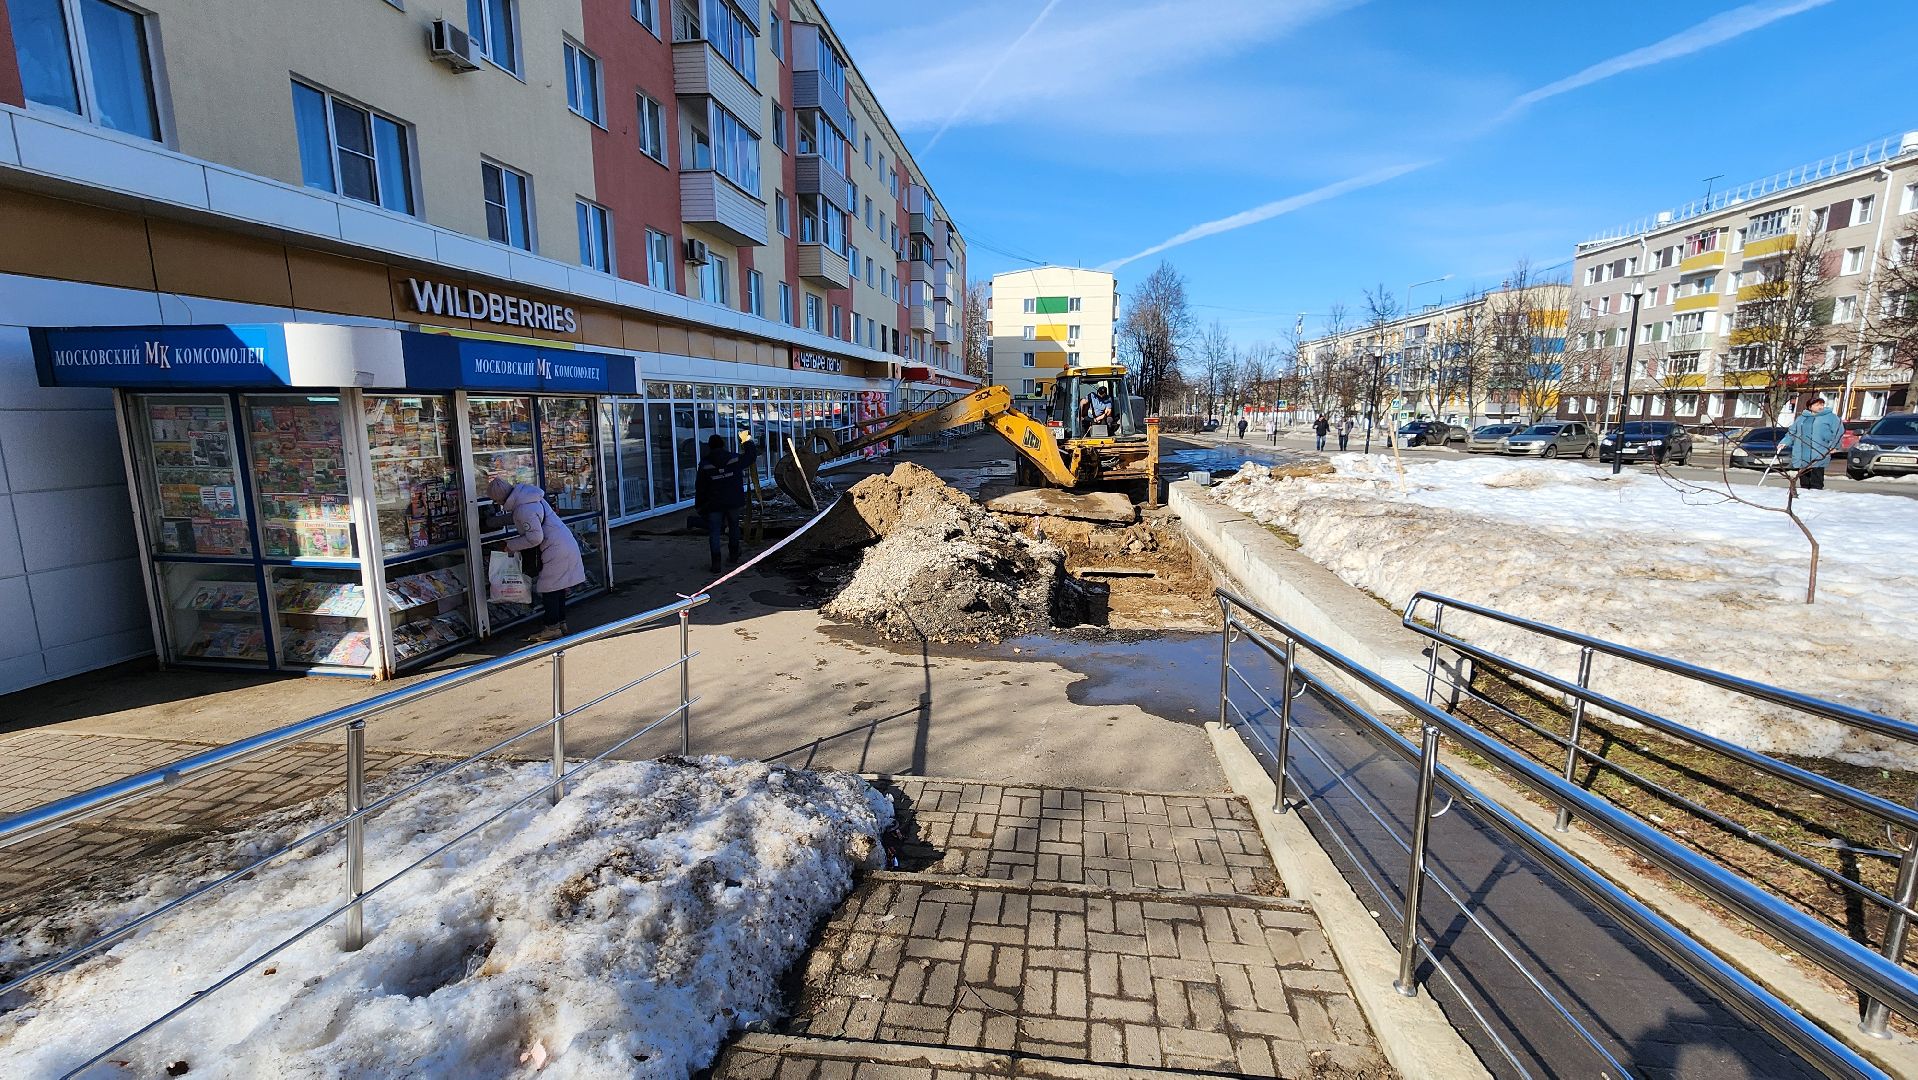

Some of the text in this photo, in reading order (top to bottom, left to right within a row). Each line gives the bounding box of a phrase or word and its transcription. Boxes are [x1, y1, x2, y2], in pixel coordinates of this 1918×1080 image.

[409, 278, 577, 333] WILDBERRIES
[54, 347, 140, 366] МОСКОВСКИЙ
[174, 347, 265, 366] КОМСОМОЛЕЦ
[475, 358, 535, 376] МОСКОВСКИЙ
[1024, 428, 1041, 450] JCB
